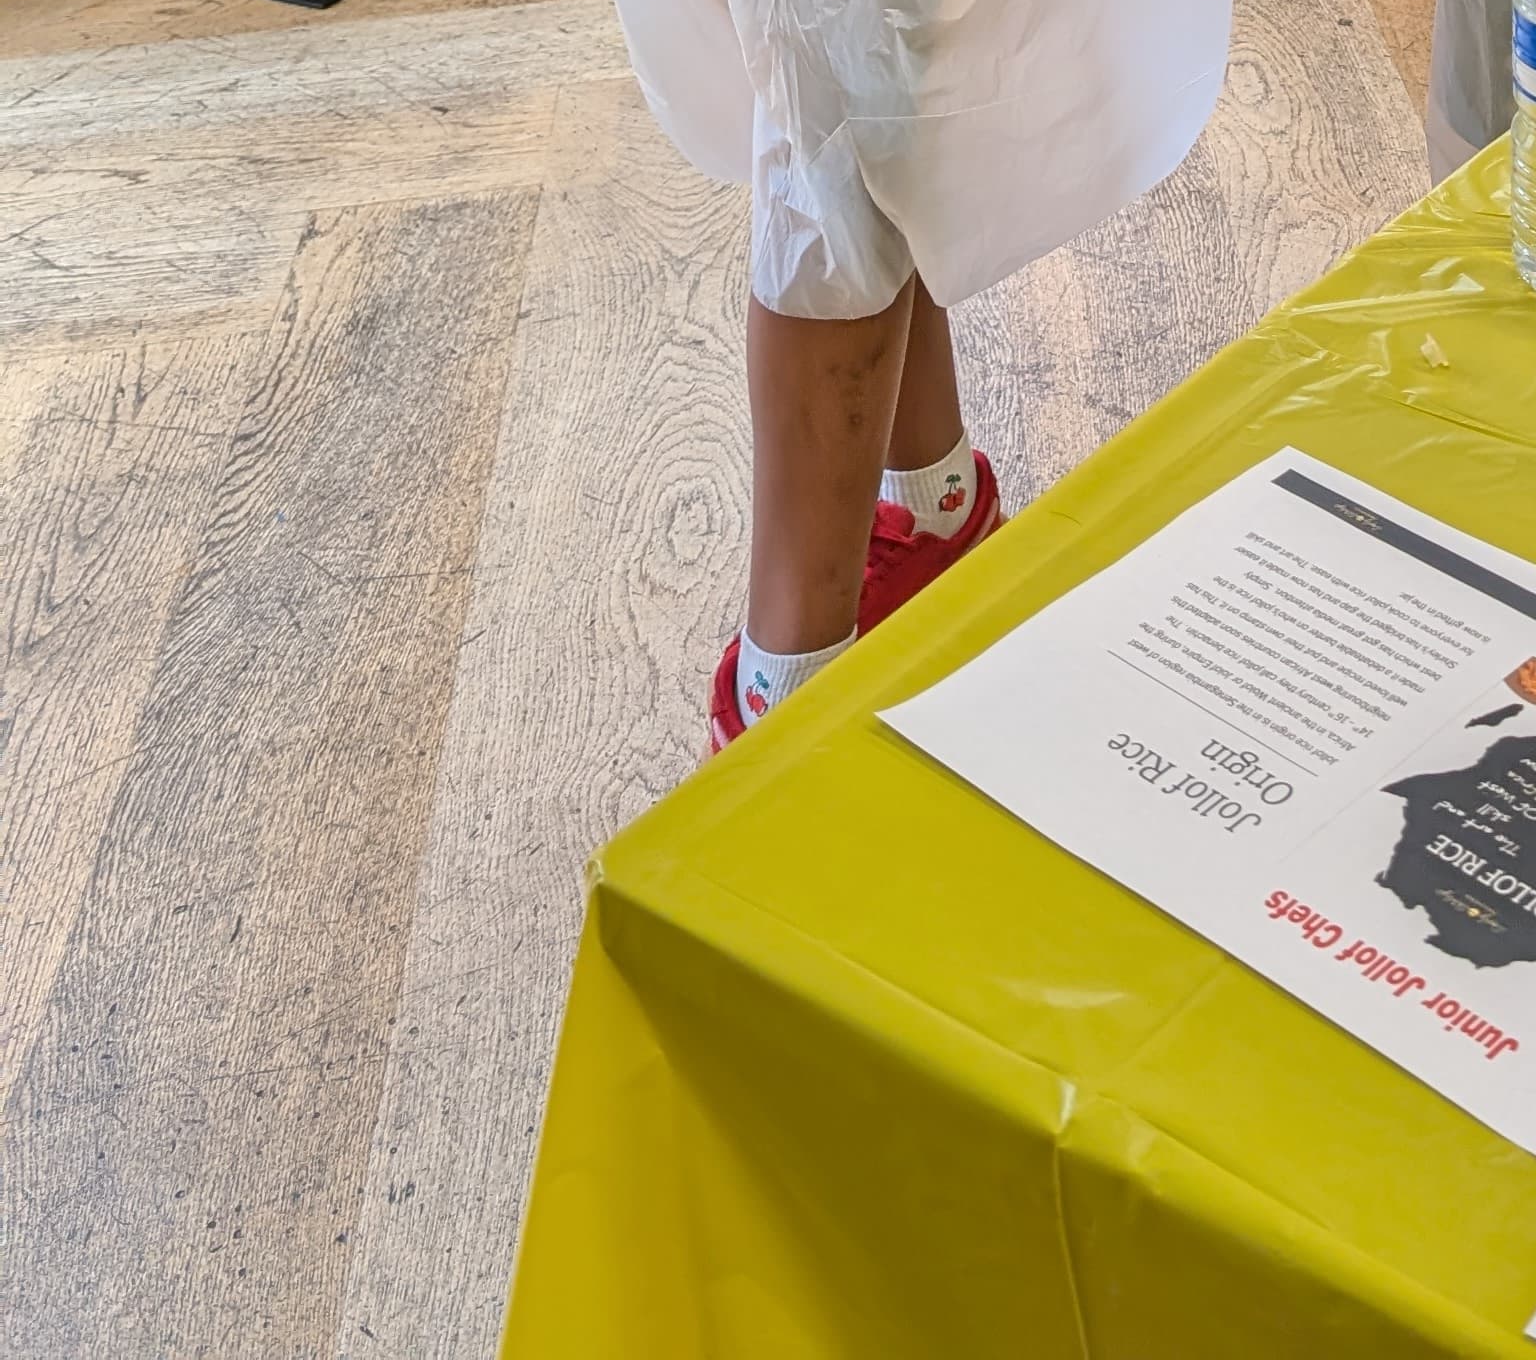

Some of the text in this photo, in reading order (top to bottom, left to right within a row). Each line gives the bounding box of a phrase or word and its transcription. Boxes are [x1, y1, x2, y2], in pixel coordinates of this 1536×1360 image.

[1107, 733, 1262, 833] Jollof Rice
[1200, 738, 1294, 806] Origin
[1476, 780, 1517, 804] West
[1432, 800, 1521, 857] The art and
[1475, 802, 1513, 823] skill
[1425, 834, 1488, 877] RICE
[1264, 890, 1520, 1061] Junior Jollof Chefs
